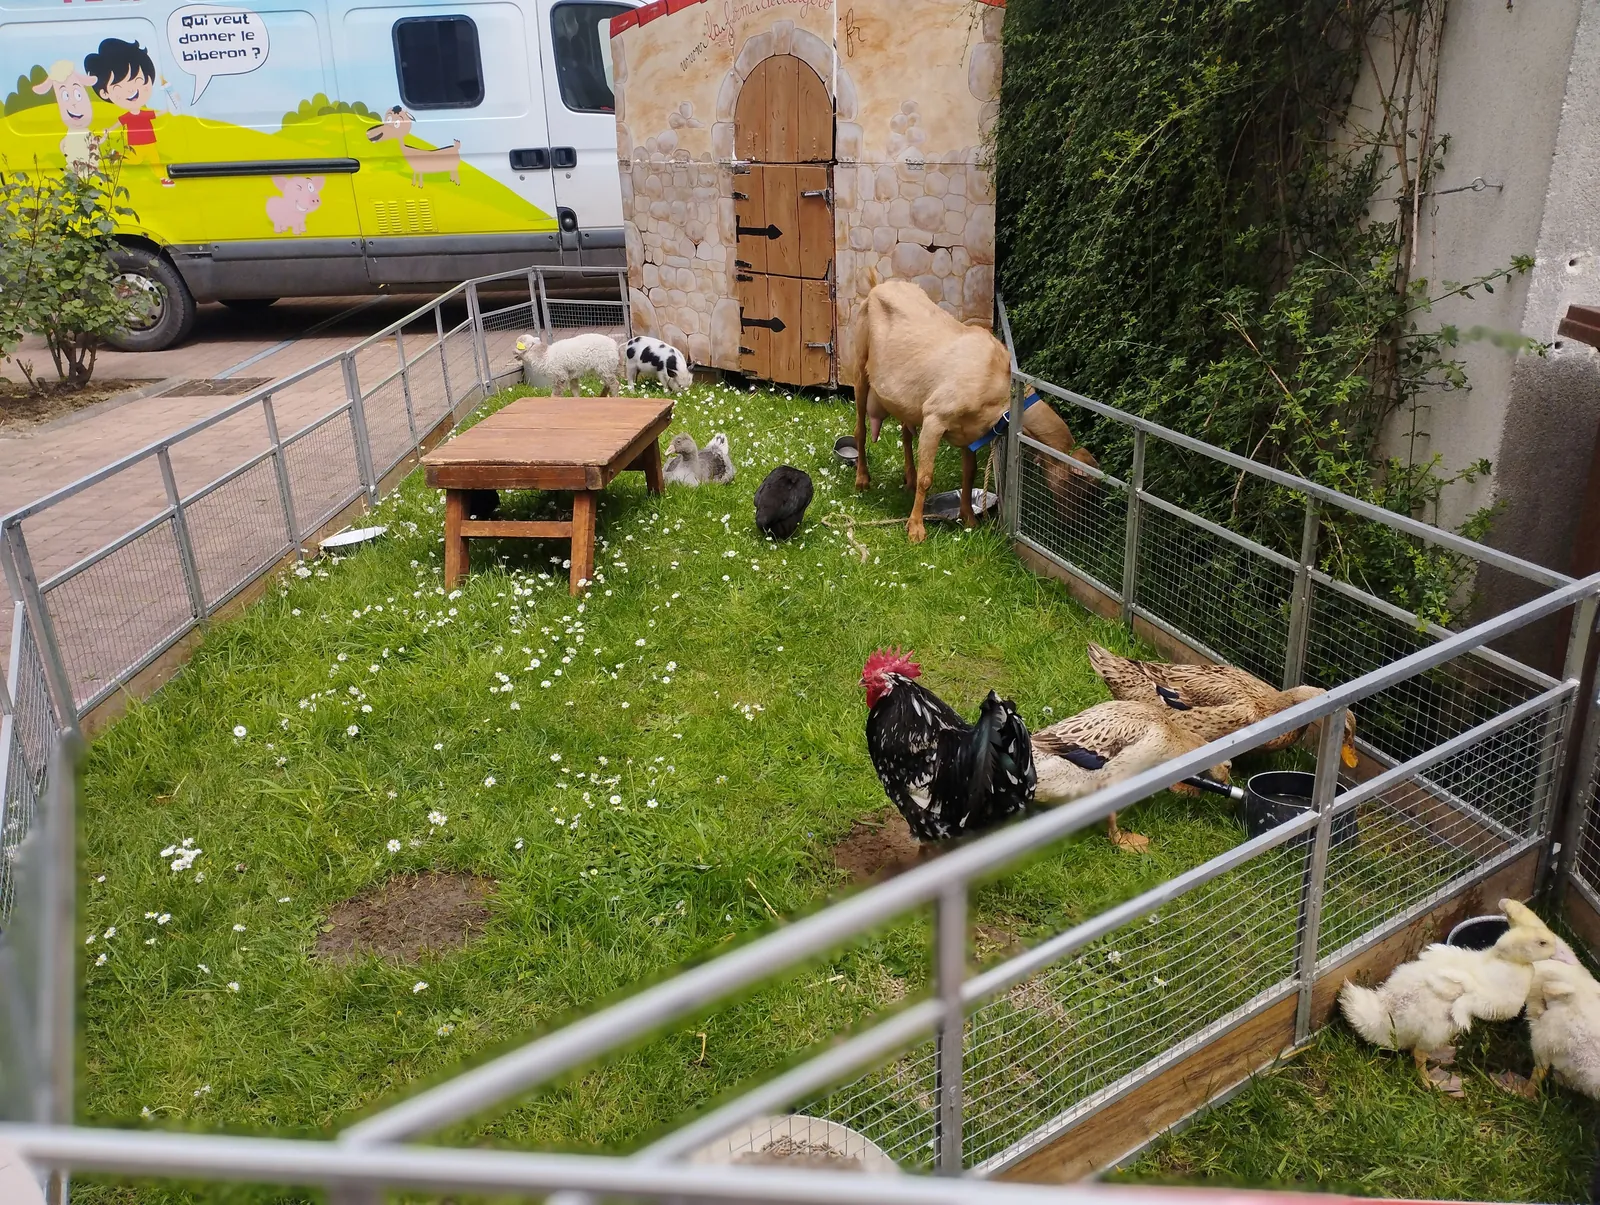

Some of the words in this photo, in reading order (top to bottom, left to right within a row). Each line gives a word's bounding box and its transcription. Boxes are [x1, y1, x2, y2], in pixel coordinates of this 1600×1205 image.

[181, 15, 208, 29] Qui
[213, 13, 250, 25] veut
[178, 32, 236, 45] donner
[240, 31, 255, 42] le
[182, 48, 247, 61] biberon
